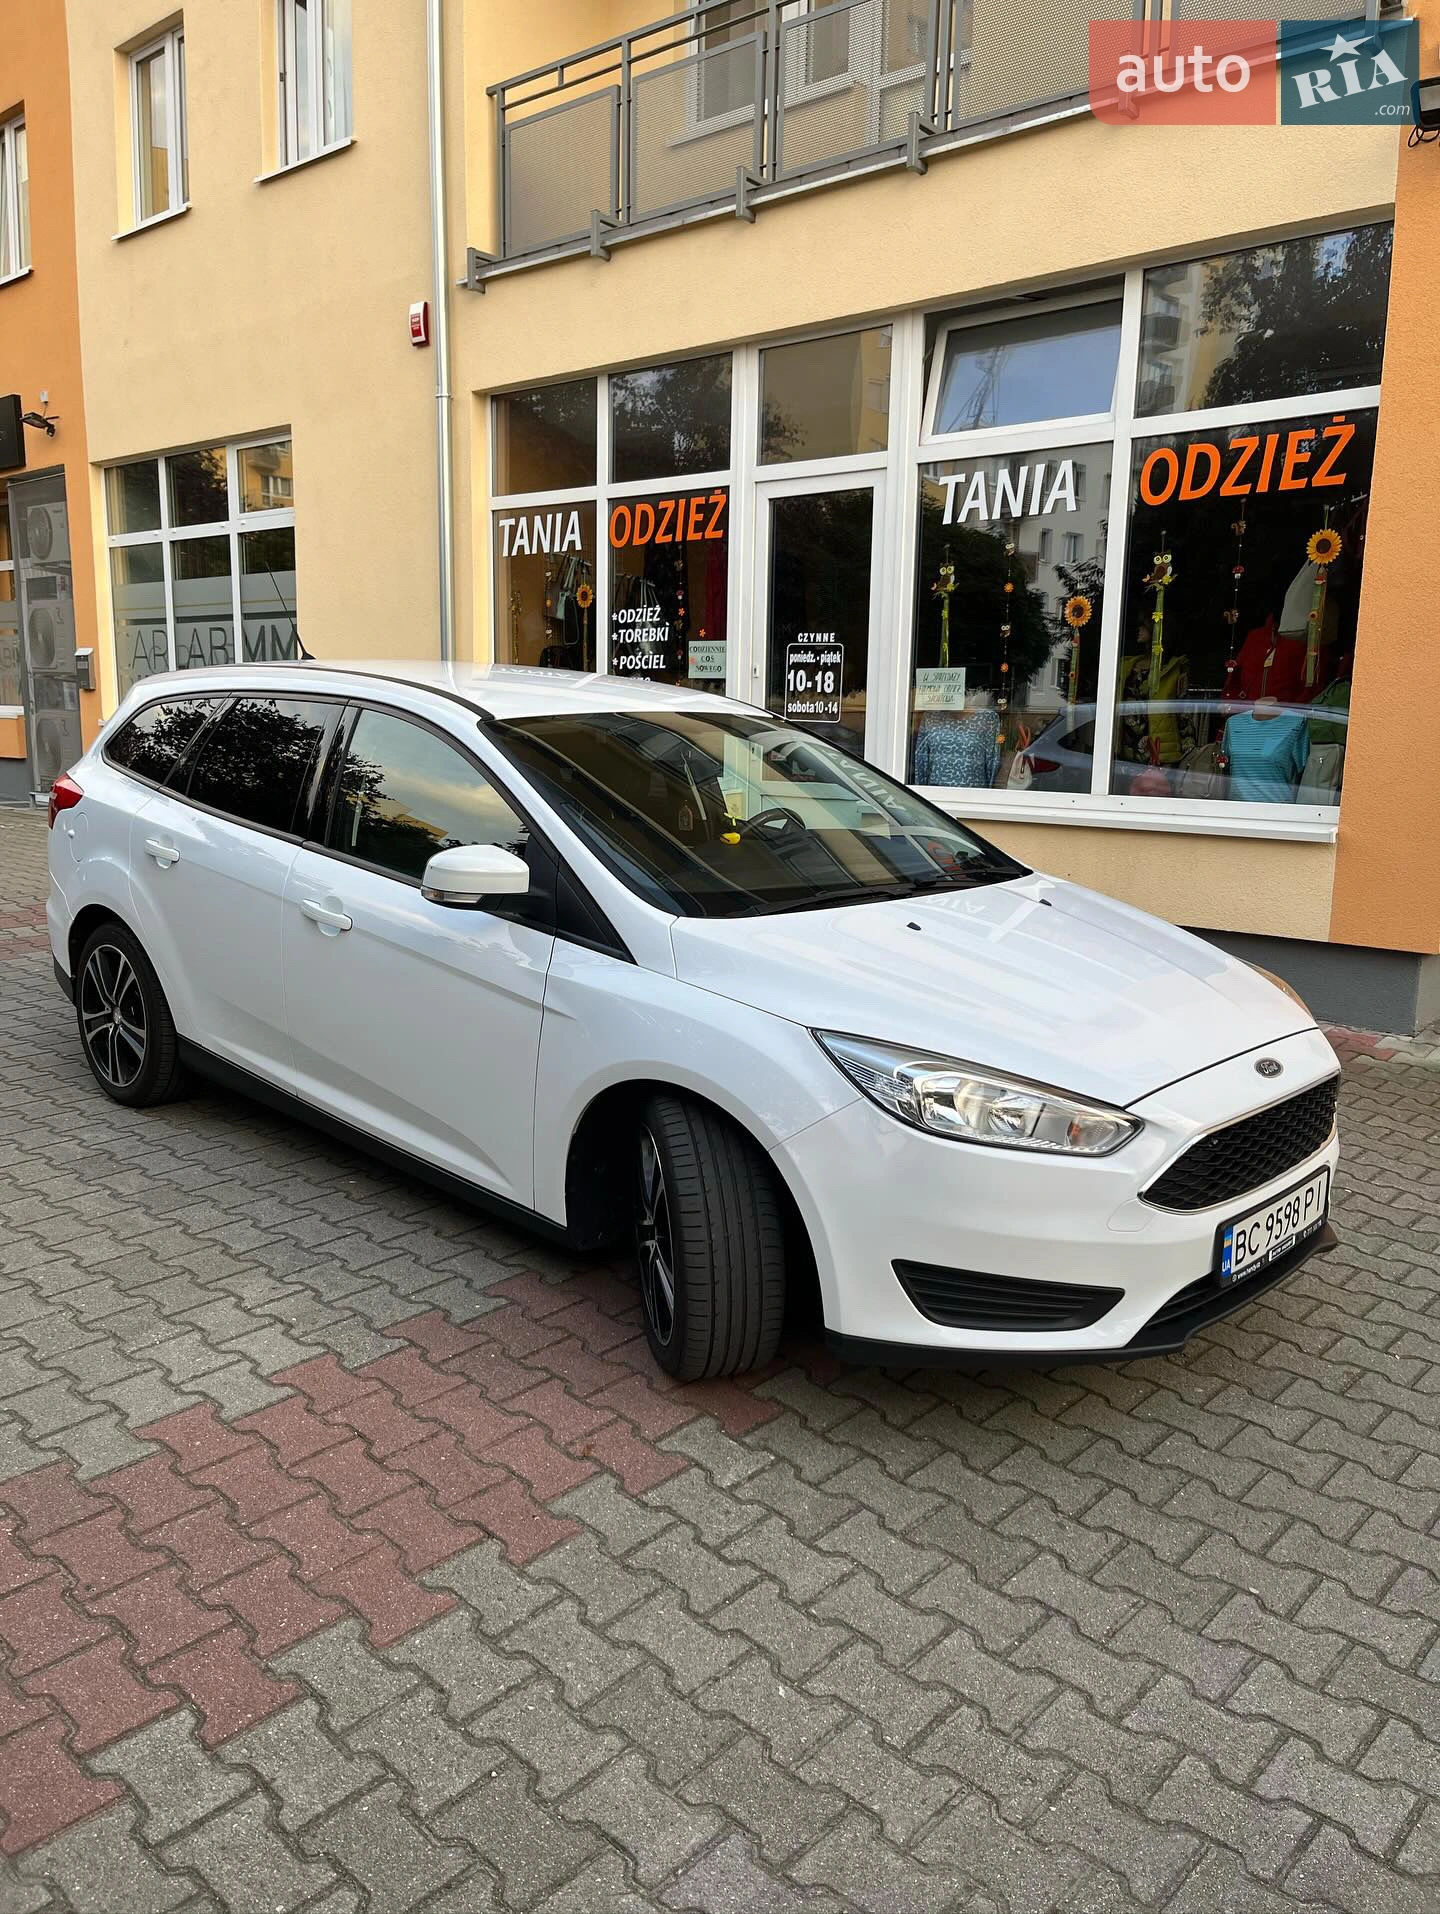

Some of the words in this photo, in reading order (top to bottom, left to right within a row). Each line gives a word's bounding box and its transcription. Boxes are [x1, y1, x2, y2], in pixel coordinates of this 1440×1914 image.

[938, 459, 1077, 526] TANIA
[1139, 416, 1356, 507] ODZIEŻ
[499, 511, 583, 557] TANIA
[609, 489, 727, 549] ODZIEŻ
[797, 632, 836, 643] CZYNNE
[820, 650, 842, 666] piątek
[787, 700, 815, 713] sobota
[1235, 1221, 1261, 1267] BC
[1265, 1195, 1301, 1248] 9598
[1303, 1180, 1322, 1221] PI
[1221, 1259, 1231, 1273] UA
